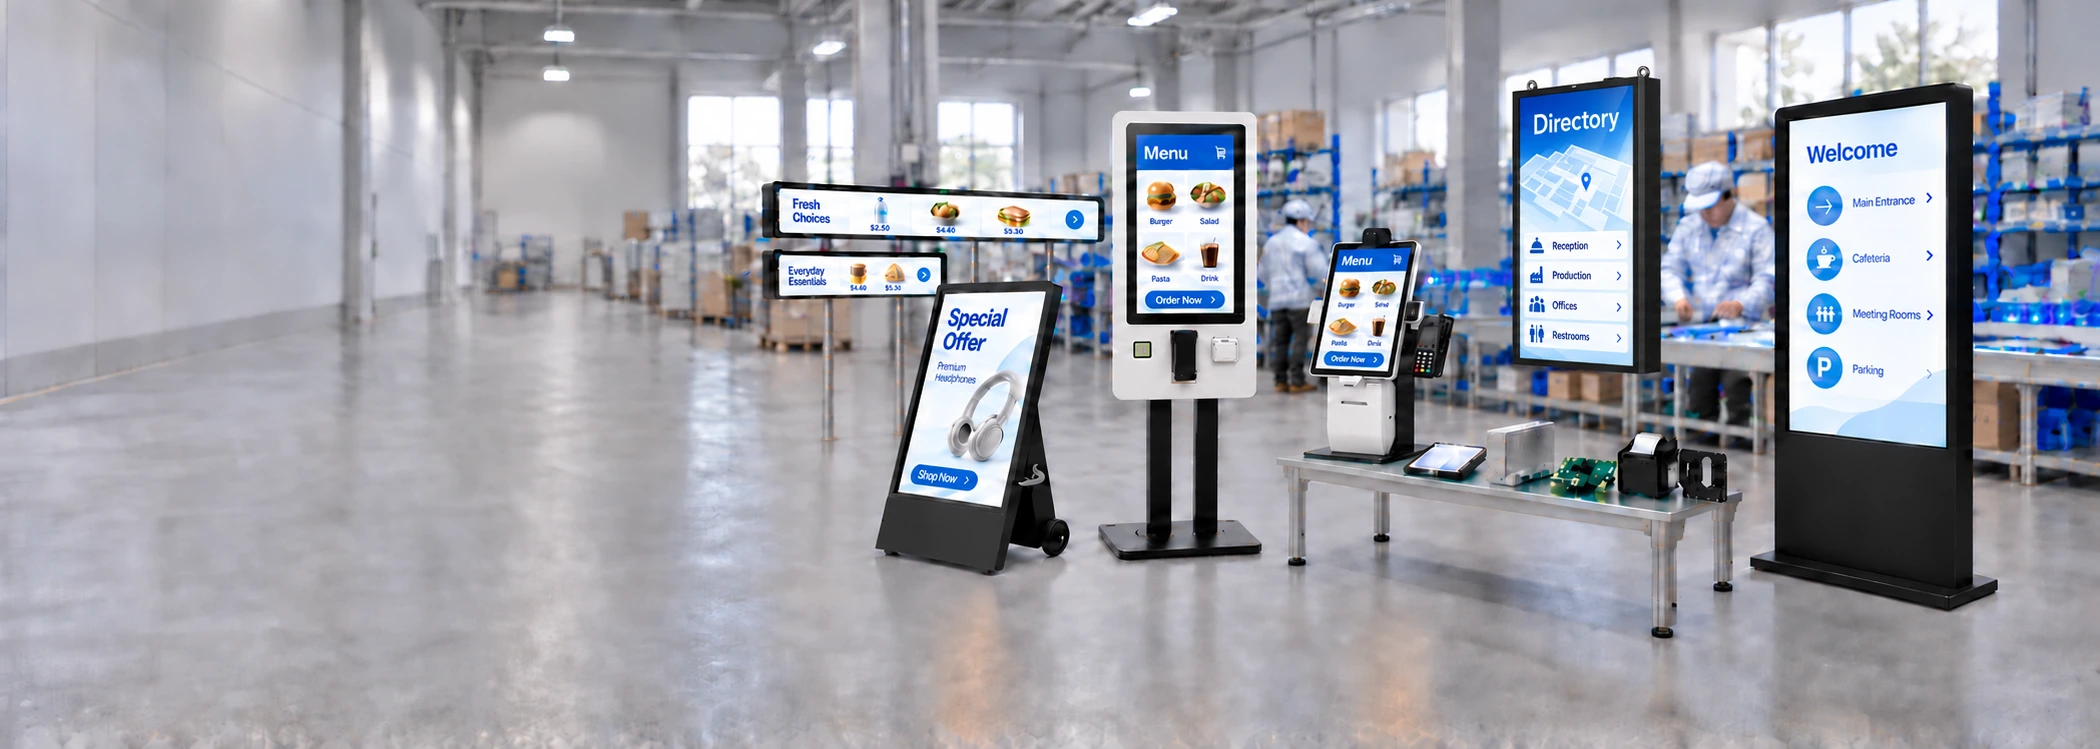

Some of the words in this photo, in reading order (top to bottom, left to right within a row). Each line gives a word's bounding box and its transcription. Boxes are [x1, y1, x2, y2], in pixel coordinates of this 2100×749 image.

[1534, 111, 1620, 135] Directory
[1144, 145, 1188, 160] Menu
[1806, 142, 1898, 164] Welcome
[793, 198, 820, 210] Fresh
[1852, 198, 1874, 208] Main
[1875, 196, 1916, 207] Entrance
[793, 212, 830, 224] Choices
[1149, 217, 1173, 226] Burger
[1200, 217, 1219, 225] Salad
[870, 224, 890, 232] $2.50
[1552, 241, 1588, 252] Reception
[1341, 255, 1373, 266] Menu
[1852, 253, 1891, 263] Cafeteria
[788, 266, 825, 277] Everyday
[1552, 270, 1592, 280] Production
[788, 277, 827, 286] Essentials
[1155, 296, 1181, 304] Order
[1182, 296, 1203, 304] Now
[1552, 300, 1578, 310] Offices
[948, 308, 1008, 331] Special
[1852, 308, 1888, 322] Meeting
[1889, 309, 1922, 320] Rooms
[1552, 330, 1590, 341] Restrooms
[943, 332, 987, 351] Offer
[1331, 354, 1350, 362] Order
[937, 361, 966, 371] Premium
[1852, 363, 1884, 378] Parking
[935, 373, 976, 384] Headphones
[917, 469, 938, 484] Shop
[938, 472, 958, 483] Now
